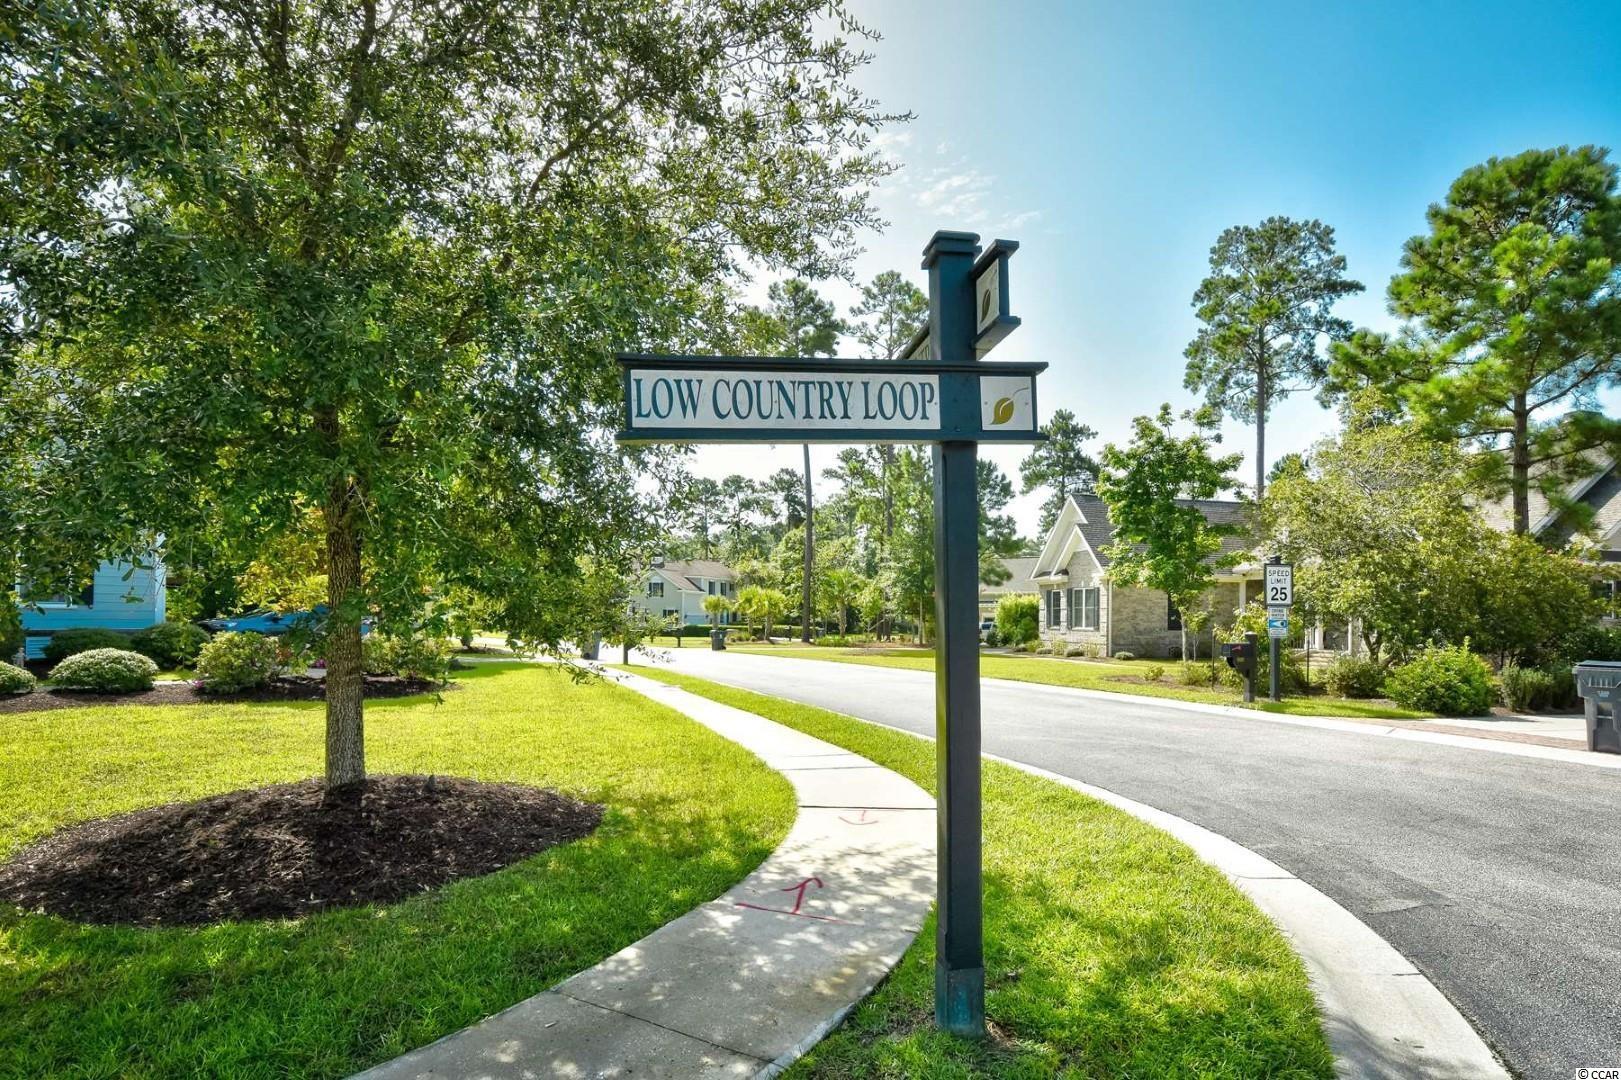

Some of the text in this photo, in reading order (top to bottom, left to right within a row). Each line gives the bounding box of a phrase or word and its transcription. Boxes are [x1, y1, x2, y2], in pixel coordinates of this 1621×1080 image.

[633, 377, 935, 420] LOW COUNTRY LOOP
[1268, 569, 1290, 577] SPEED
[1270, 587, 1288, 601] 25
